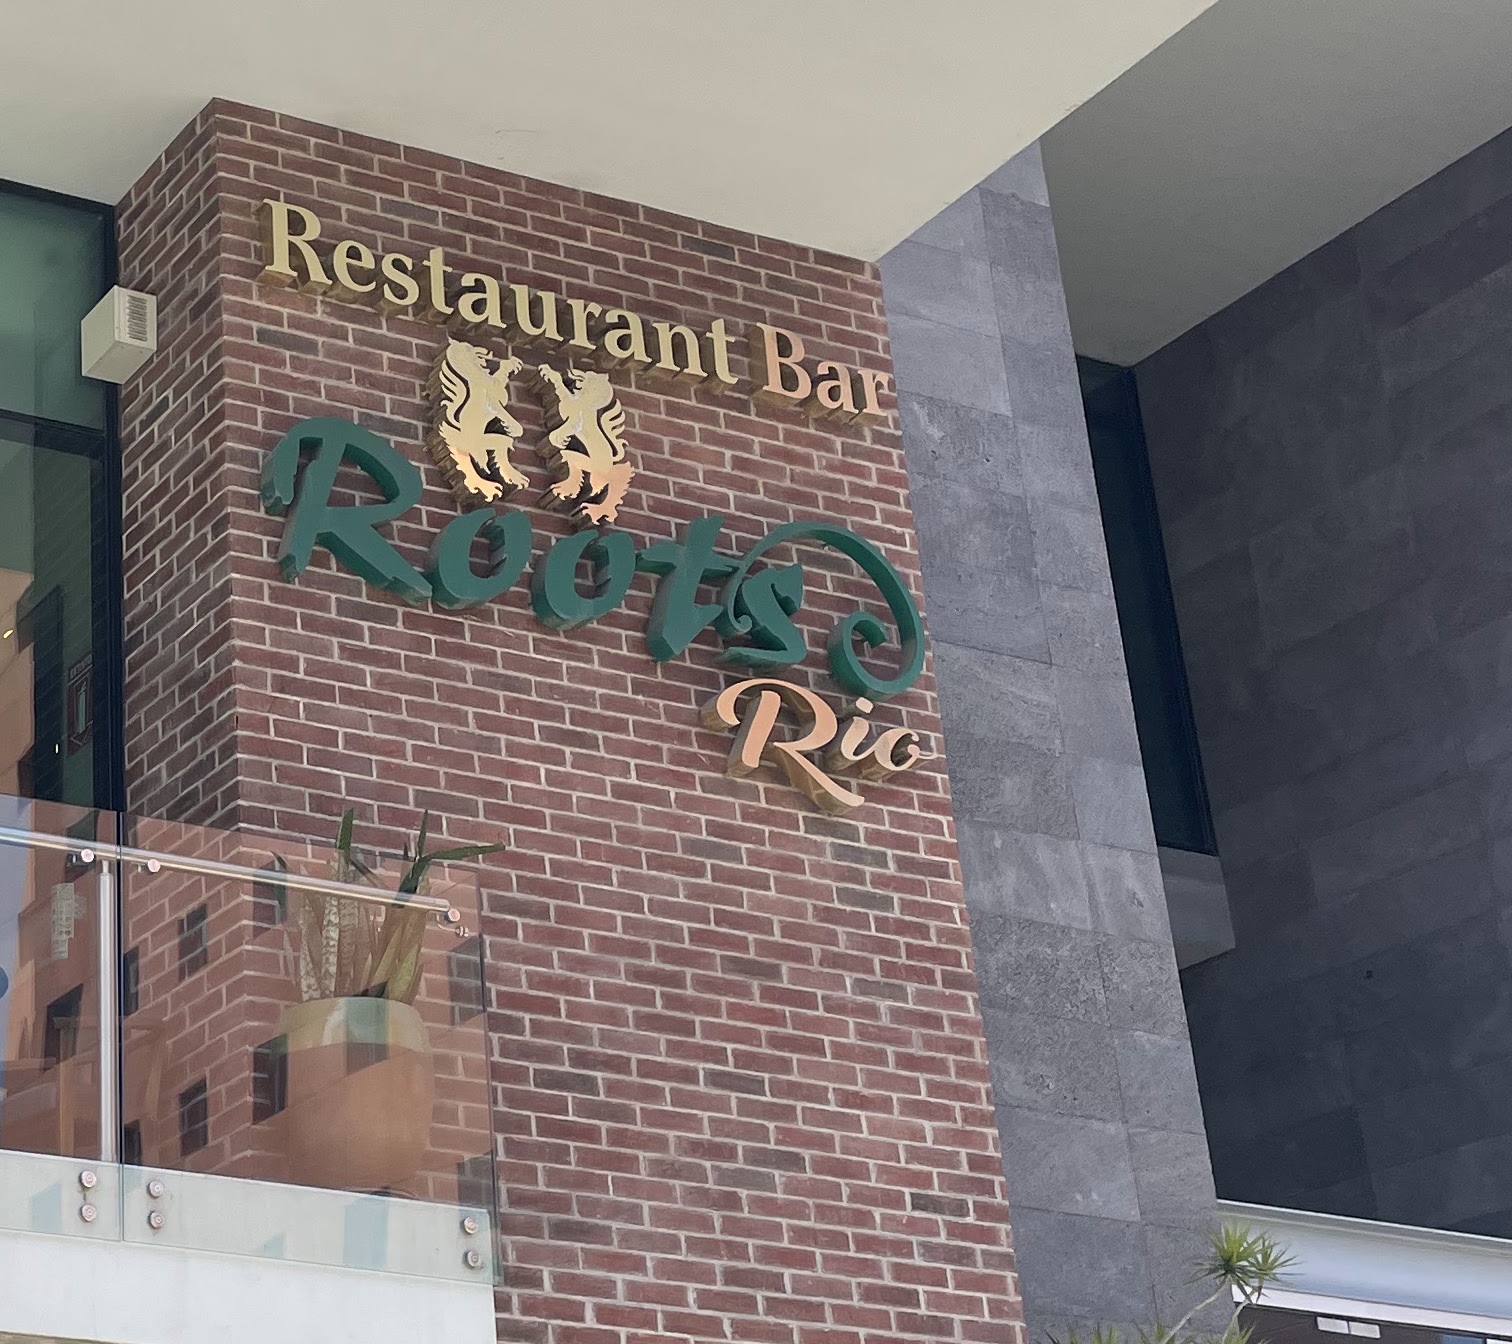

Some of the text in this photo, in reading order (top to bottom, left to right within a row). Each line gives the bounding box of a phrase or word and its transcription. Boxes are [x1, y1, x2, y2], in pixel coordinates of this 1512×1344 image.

[258, 198, 890, 424] Restaurant Bar
[259, 417, 927, 699] Roots
[700, 678, 945, 816] Rio
